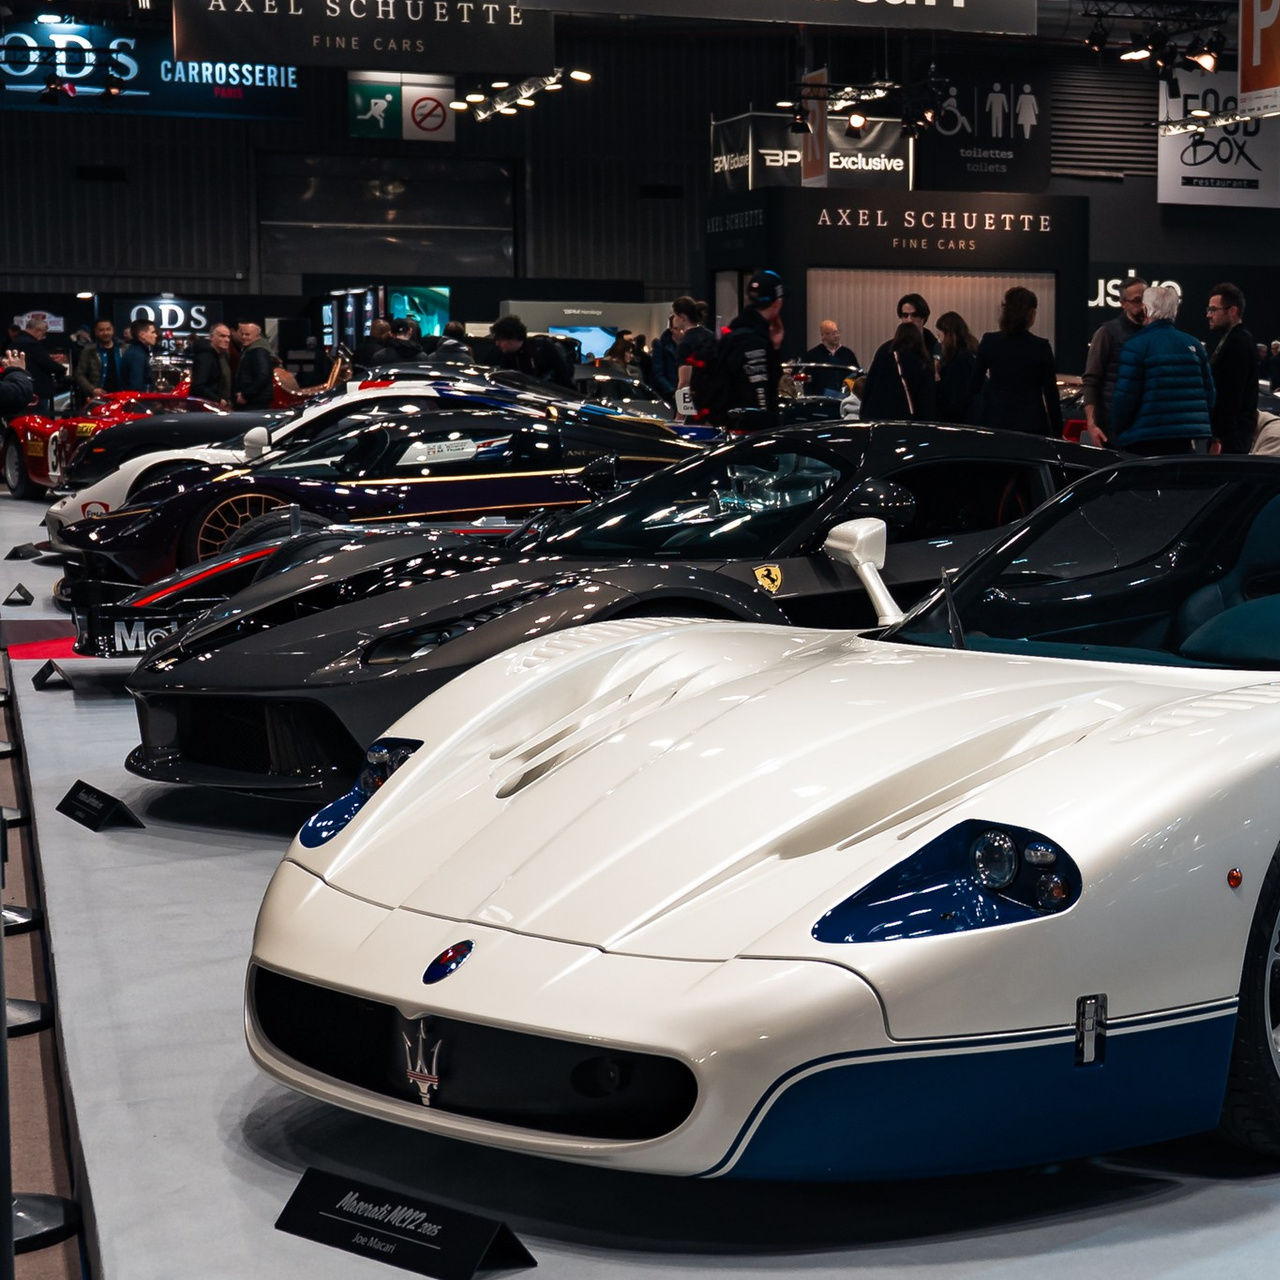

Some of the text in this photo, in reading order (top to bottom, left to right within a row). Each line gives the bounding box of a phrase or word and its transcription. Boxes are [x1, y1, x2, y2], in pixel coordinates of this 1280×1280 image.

[312, 35, 425, 53] FINE CARS
[160, 60, 298, 88] CARROSSERIE
[214, 87, 243, 99] PARIS
[758, 150, 904, 171] BP Exclusive
[960, 147, 1014, 159] toilettes
[966, 162, 1007, 173] toilets
[1192, 178, 1249, 189] restaurant
[817, 208, 1051, 232] AXEL SCHUETTE
[893, 238, 976, 251] FINE CARS
[130, 304, 208, 329] ODS
[335, 1191, 442, 1237] Maserati MC12 2005
[352, 1232, 397, 1254] Joe Macari
